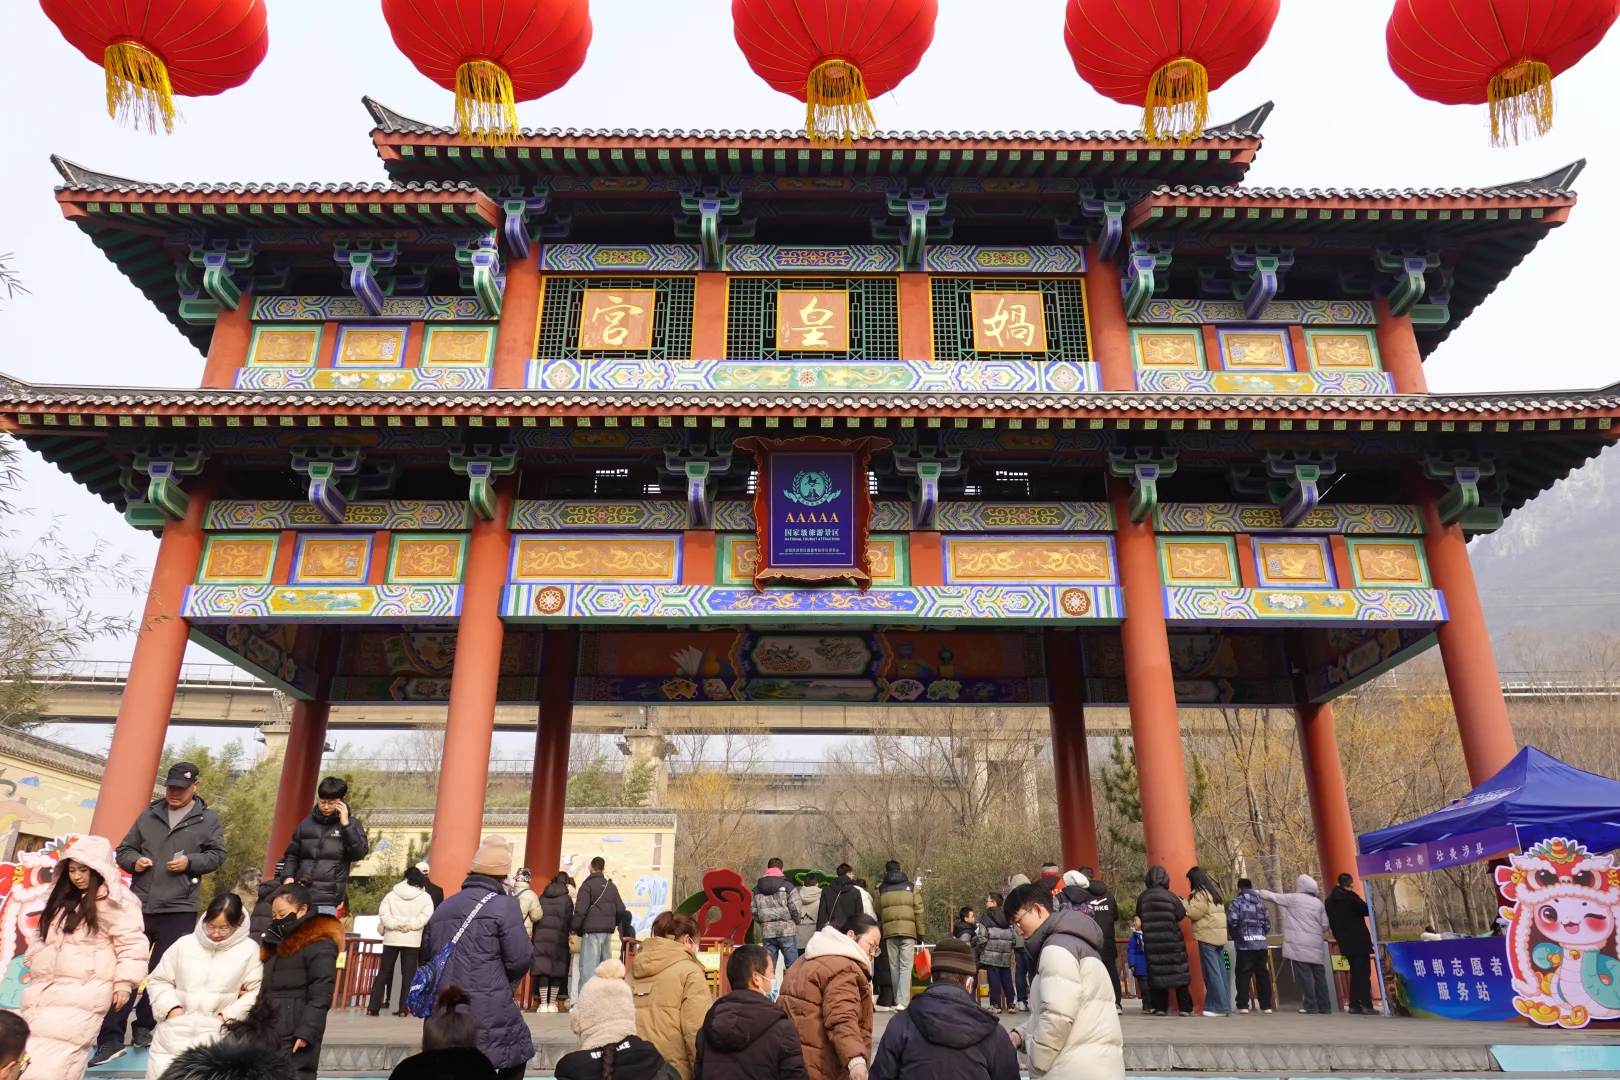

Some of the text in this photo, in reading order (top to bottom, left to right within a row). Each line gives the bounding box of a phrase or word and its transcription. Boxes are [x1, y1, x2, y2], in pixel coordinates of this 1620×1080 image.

[791, 296, 834, 346] 皇
[784, 528, 839, 536] 国家级旅游景区
[1384, 842, 1484, 872] 成语之都 壮美涉县
[1413, 956, 1503, 977] 邯郸志愿者
[1436, 981, 1491, 1001] 服务站
